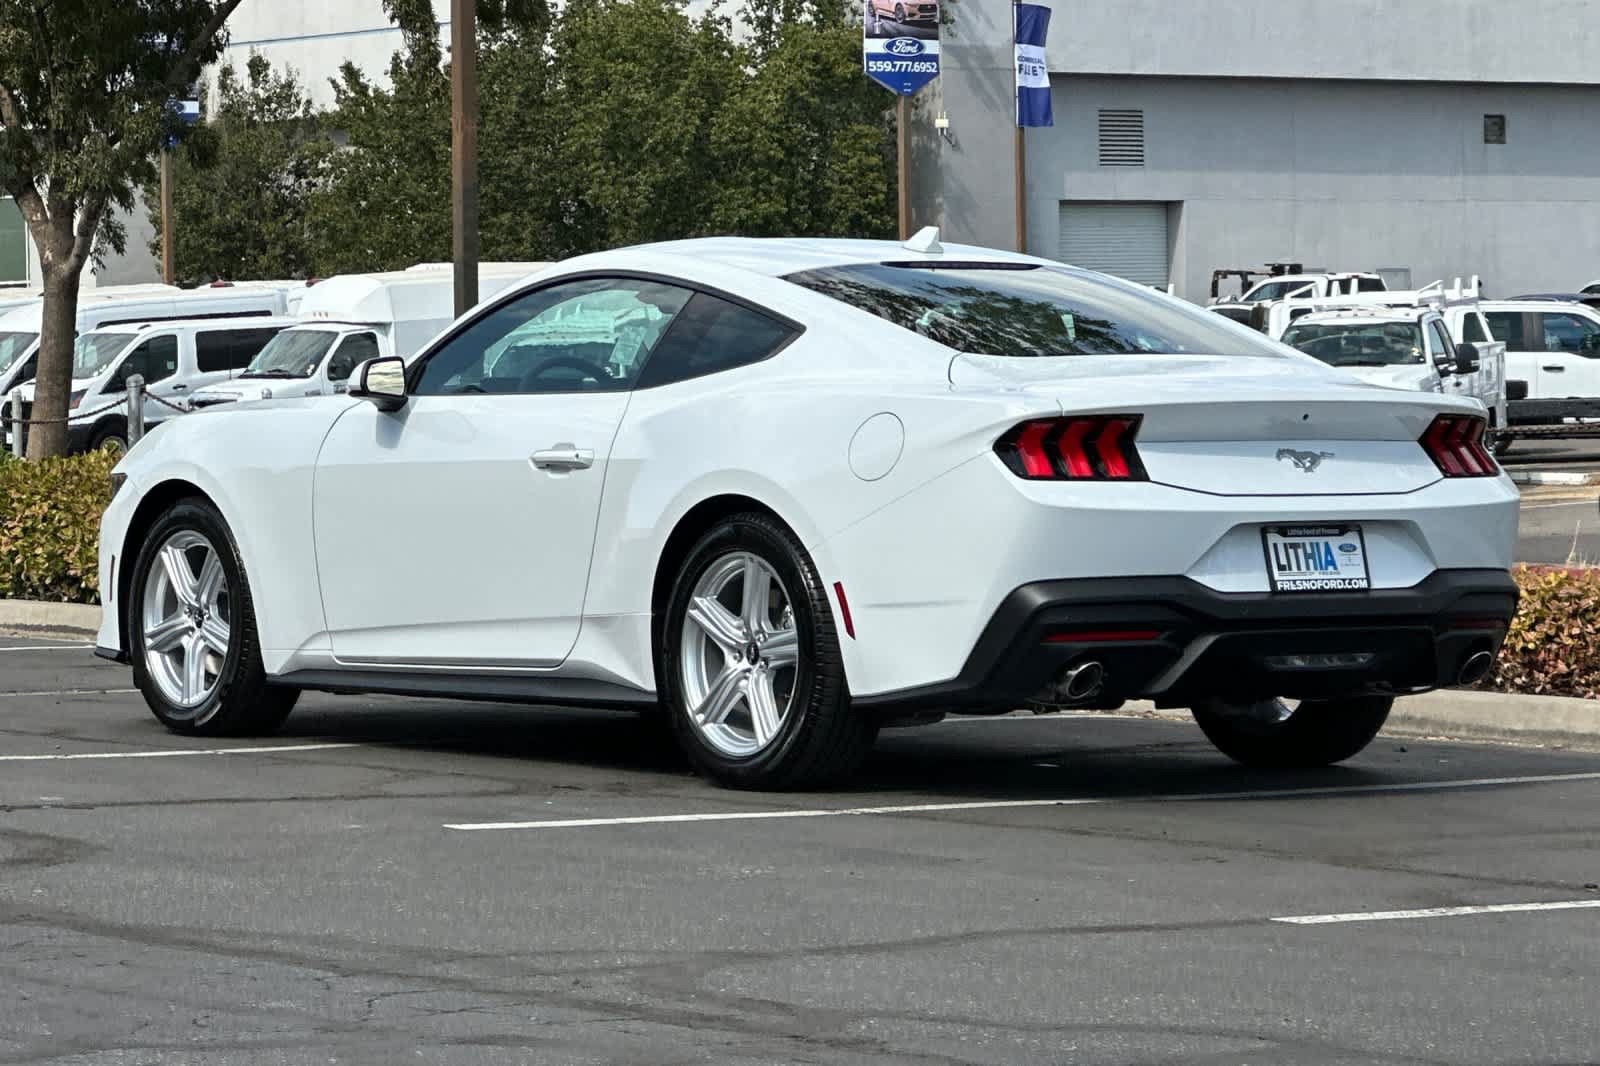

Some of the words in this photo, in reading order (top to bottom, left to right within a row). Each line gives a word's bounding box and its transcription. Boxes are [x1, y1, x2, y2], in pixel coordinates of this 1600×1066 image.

[891, 38, 920, 54] Ford
[869, 61, 937, 72] 559.777.6952
[1273, 542, 1338, 571] LITHIA
